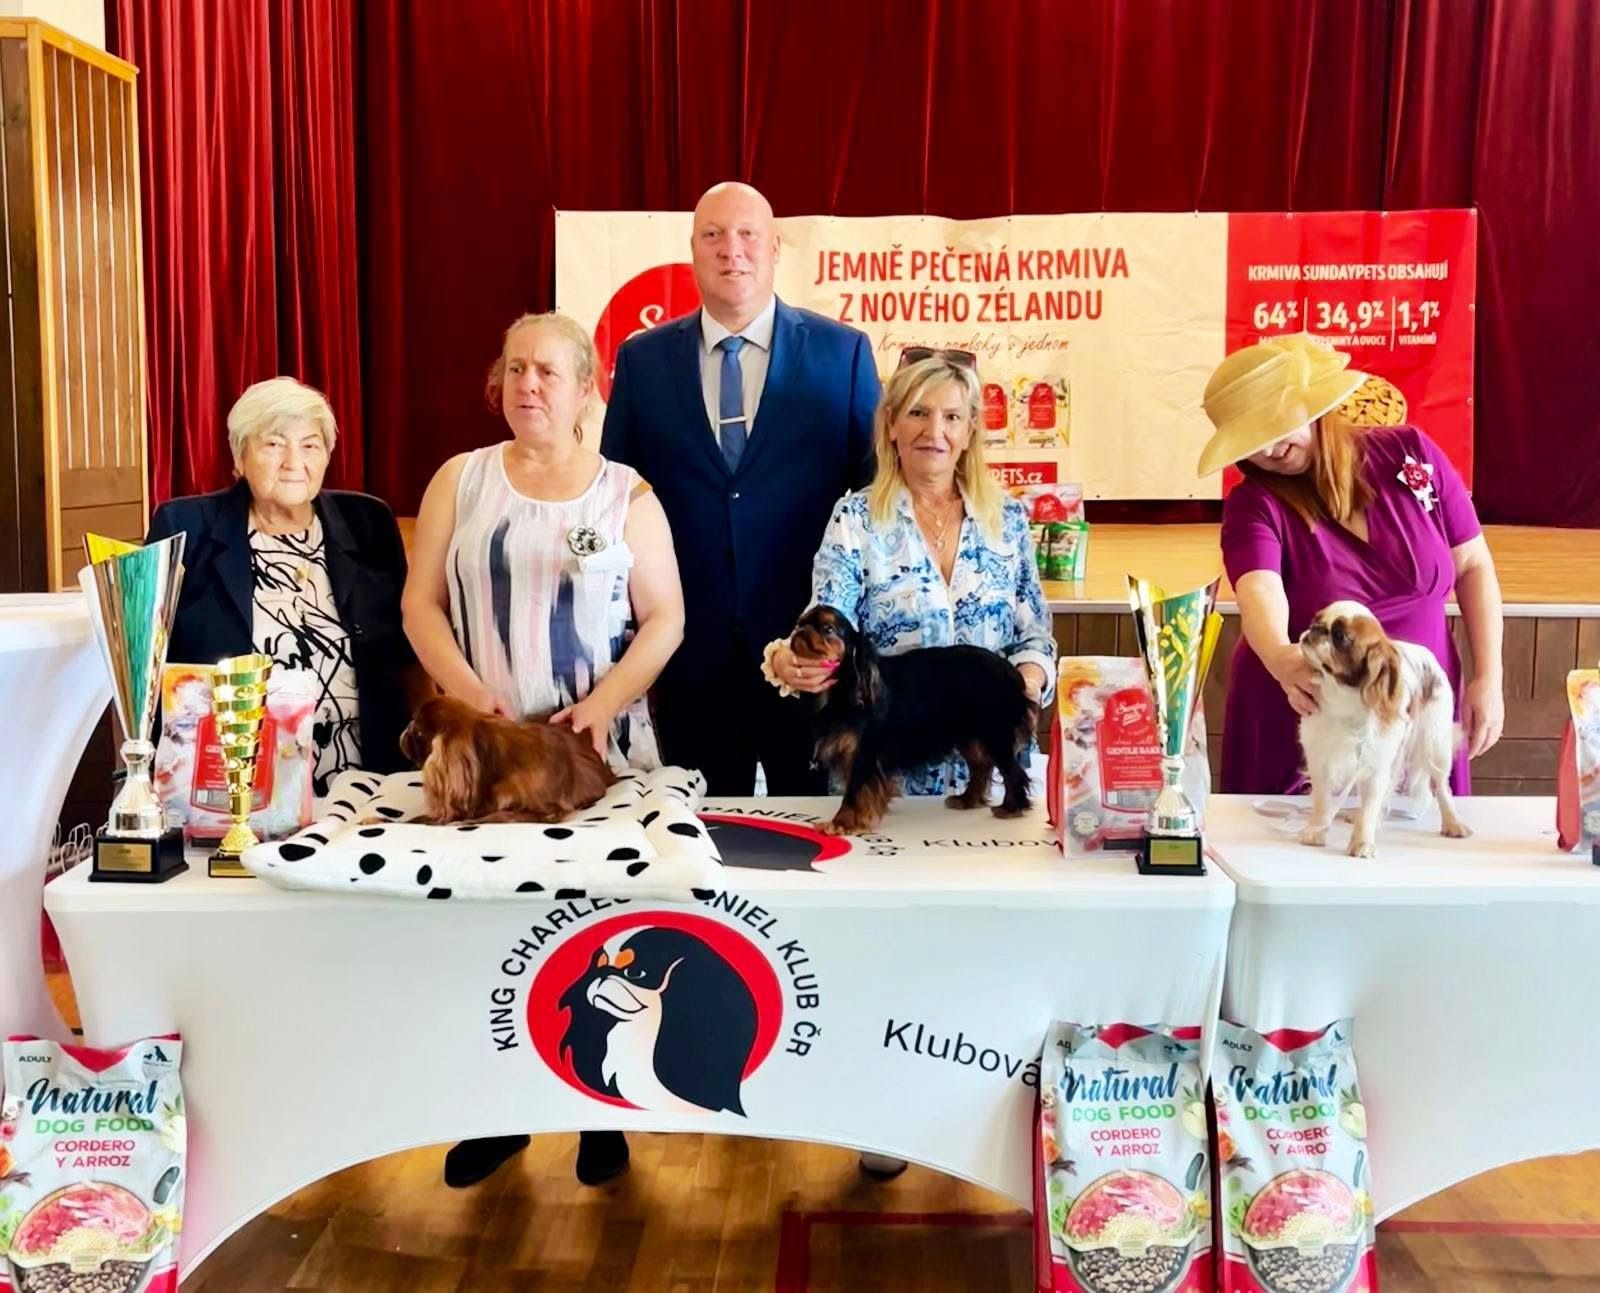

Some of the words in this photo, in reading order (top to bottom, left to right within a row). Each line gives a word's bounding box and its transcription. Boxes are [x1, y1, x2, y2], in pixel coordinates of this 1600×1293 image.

[814, 244, 903, 285] JEMNĚ
[911, 245, 1010, 282] PEČENÁ
[1018, 248, 1129, 281] KRMIVA
[1248, 264, 1300, 280] KRMIVA
[1303, 264, 1386, 280] SUNDAYPETS
[1388, 259, 1448, 280] OBSAHUJÍ
[839, 293, 853, 322] Z
[861, 286, 970, 322] NOVÉHO
[977, 286, 1102, 322] ZÉLANDU
[1253, 301, 1298, 329] 64%
[1316, 301, 1384, 333] 34,9%
[990, 467, 1043, 484] PETS.cz
[702, 806, 821, 824] PANIEL
[923, 839, 1058, 847] Klubov
[704, 890, 778, 939] NIEL
[501, 897, 631, 976] CHARLE
[776, 939, 819, 1010] KLUB
[490, 987, 519, 1051] KING
[785, 1020, 822, 1057] ČR
[1059, 1062, 1179, 1103] Natural
[26, 1077, 158, 1115] Natural
[1072, 1106, 1111, 1122] DOG
[1119, 1104, 1176, 1121] FOOD
[36, 1119, 85, 1134] DOG
[95, 1118, 155, 1132] FOOD
[1091, 1127, 1161, 1141] CORDERO
[55, 1140, 136, 1152] CORDERO
[1095, 1145, 1104, 1156] Y
[1111, 1144, 1161, 1156] ARROZ
[1269, 1144, 1280, 1155] Y
[56, 1157, 66, 1168] Y
[73, 1156, 130, 1168] ARROZ
